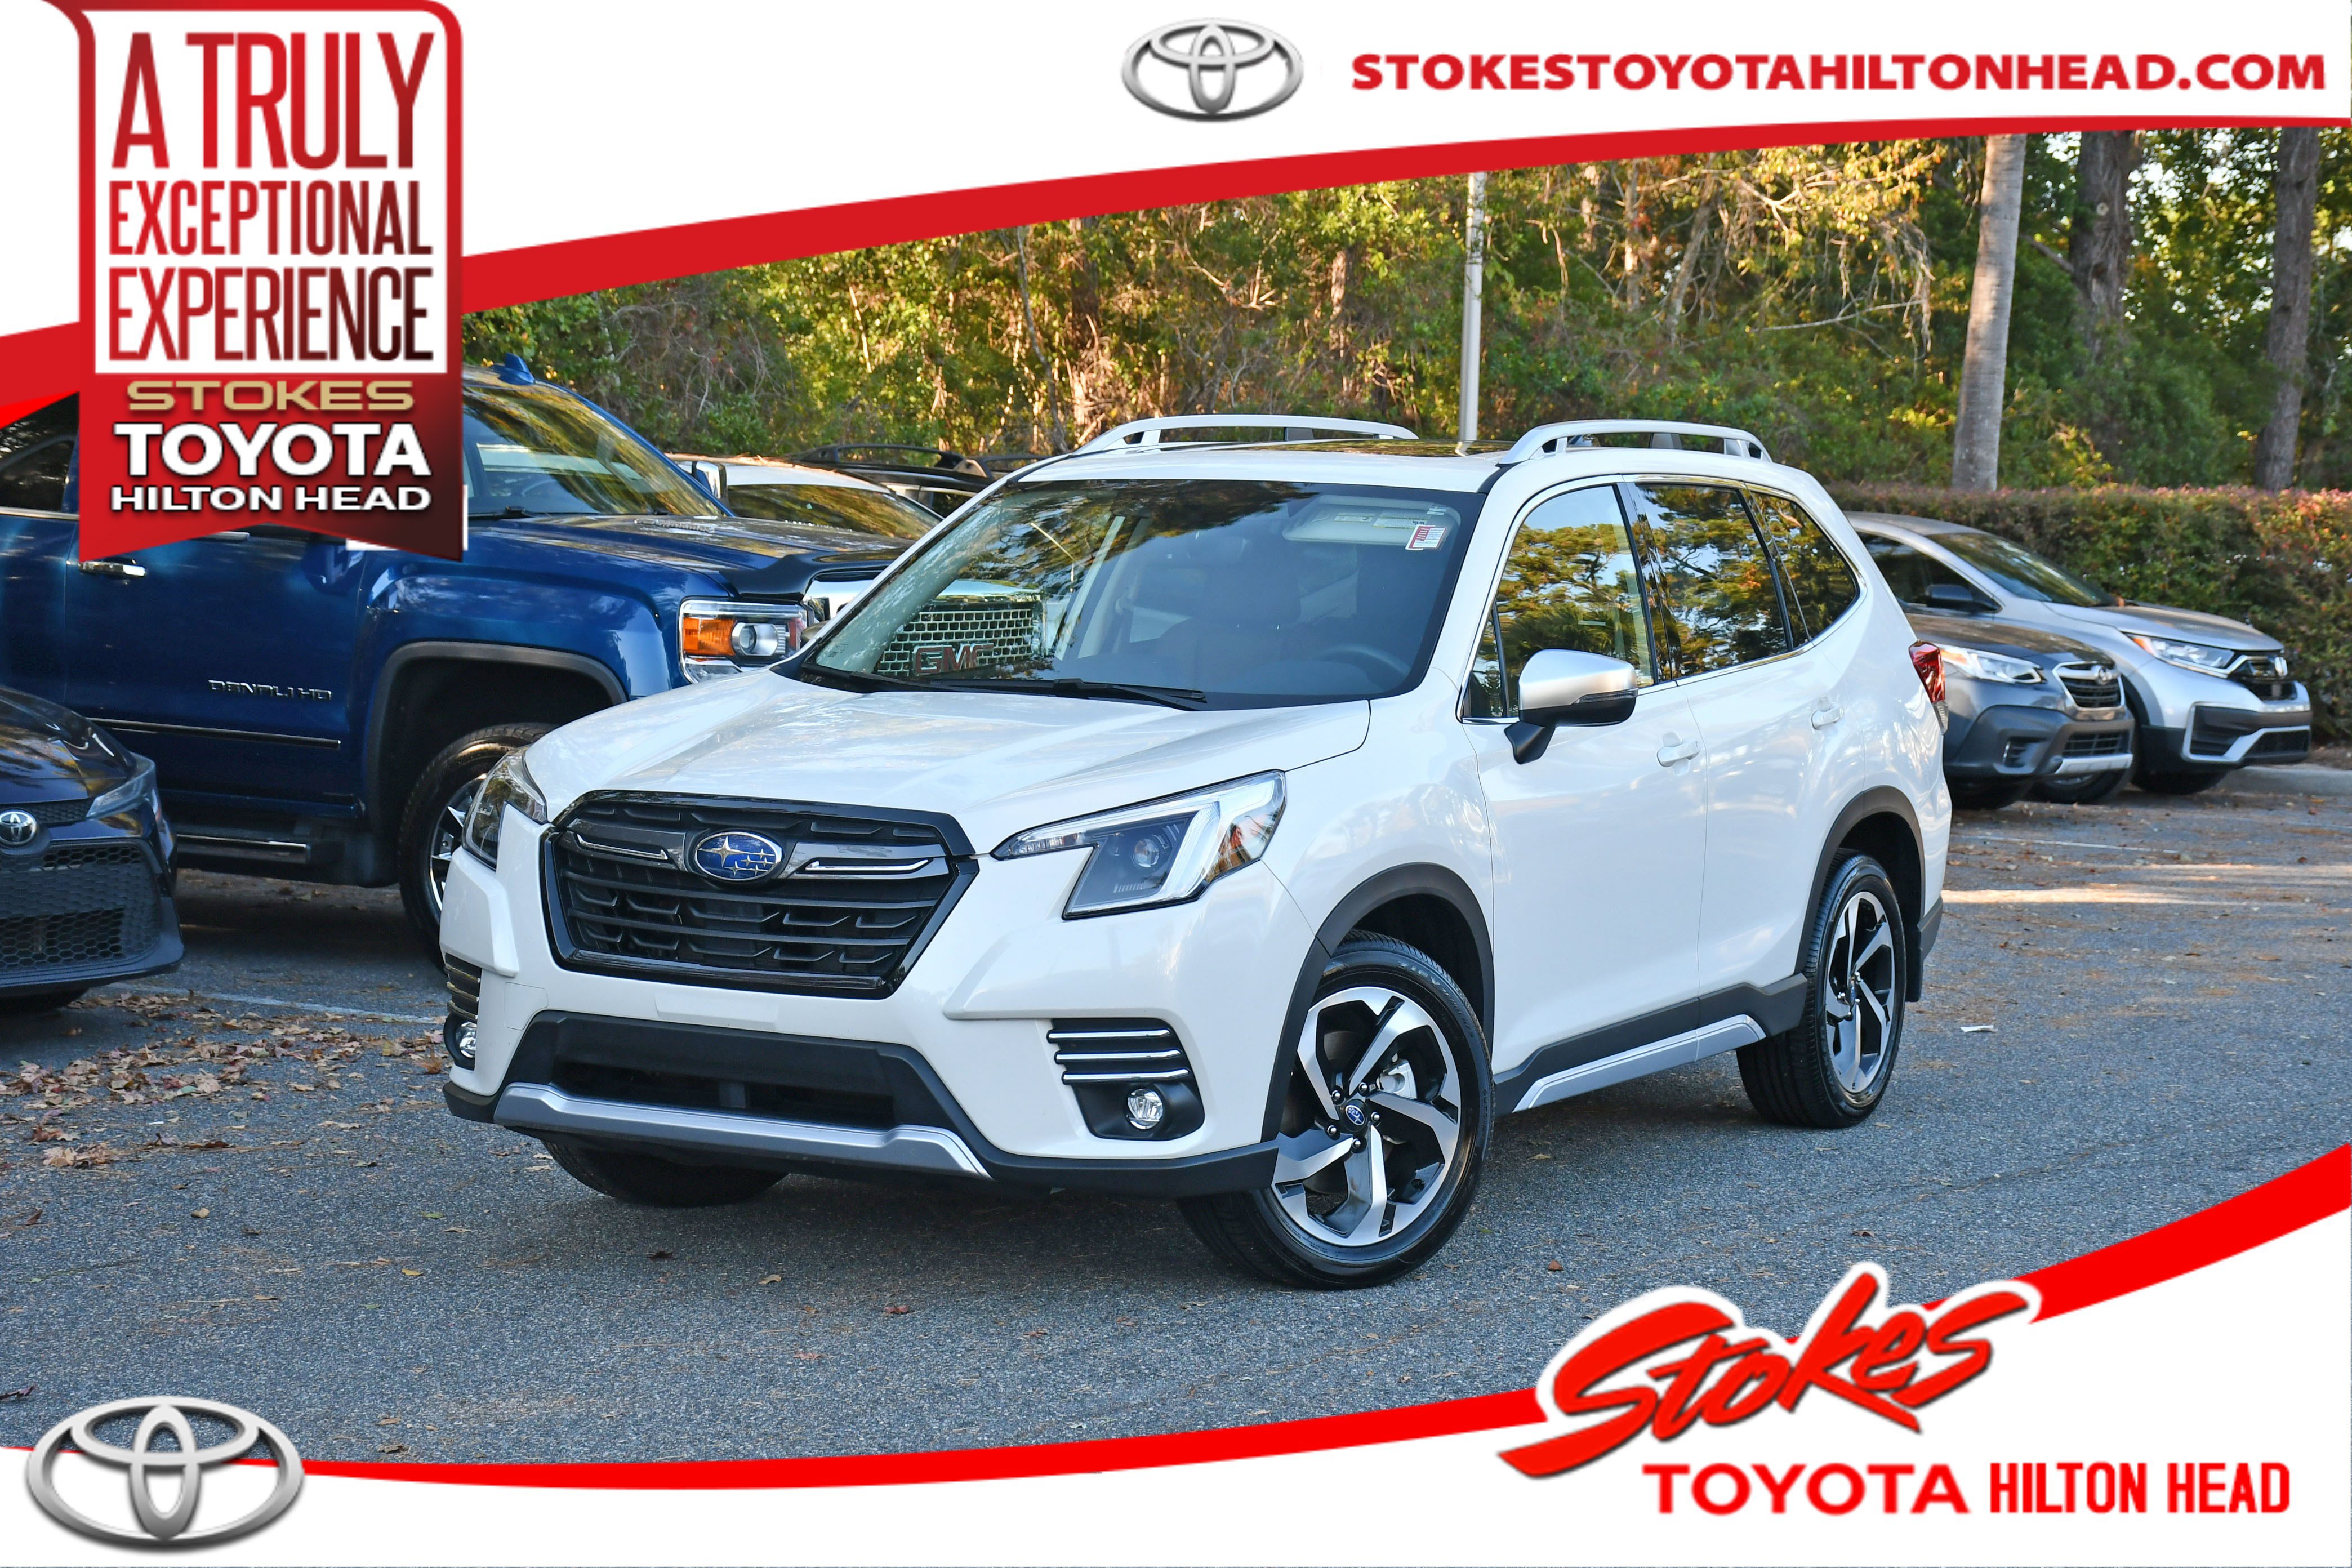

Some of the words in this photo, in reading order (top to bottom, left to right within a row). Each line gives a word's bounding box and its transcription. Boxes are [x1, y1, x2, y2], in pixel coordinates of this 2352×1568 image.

[912, 643, 995, 676] GMC
[208, 680, 294, 698] DENALI
[297, 687, 332, 702] HD
